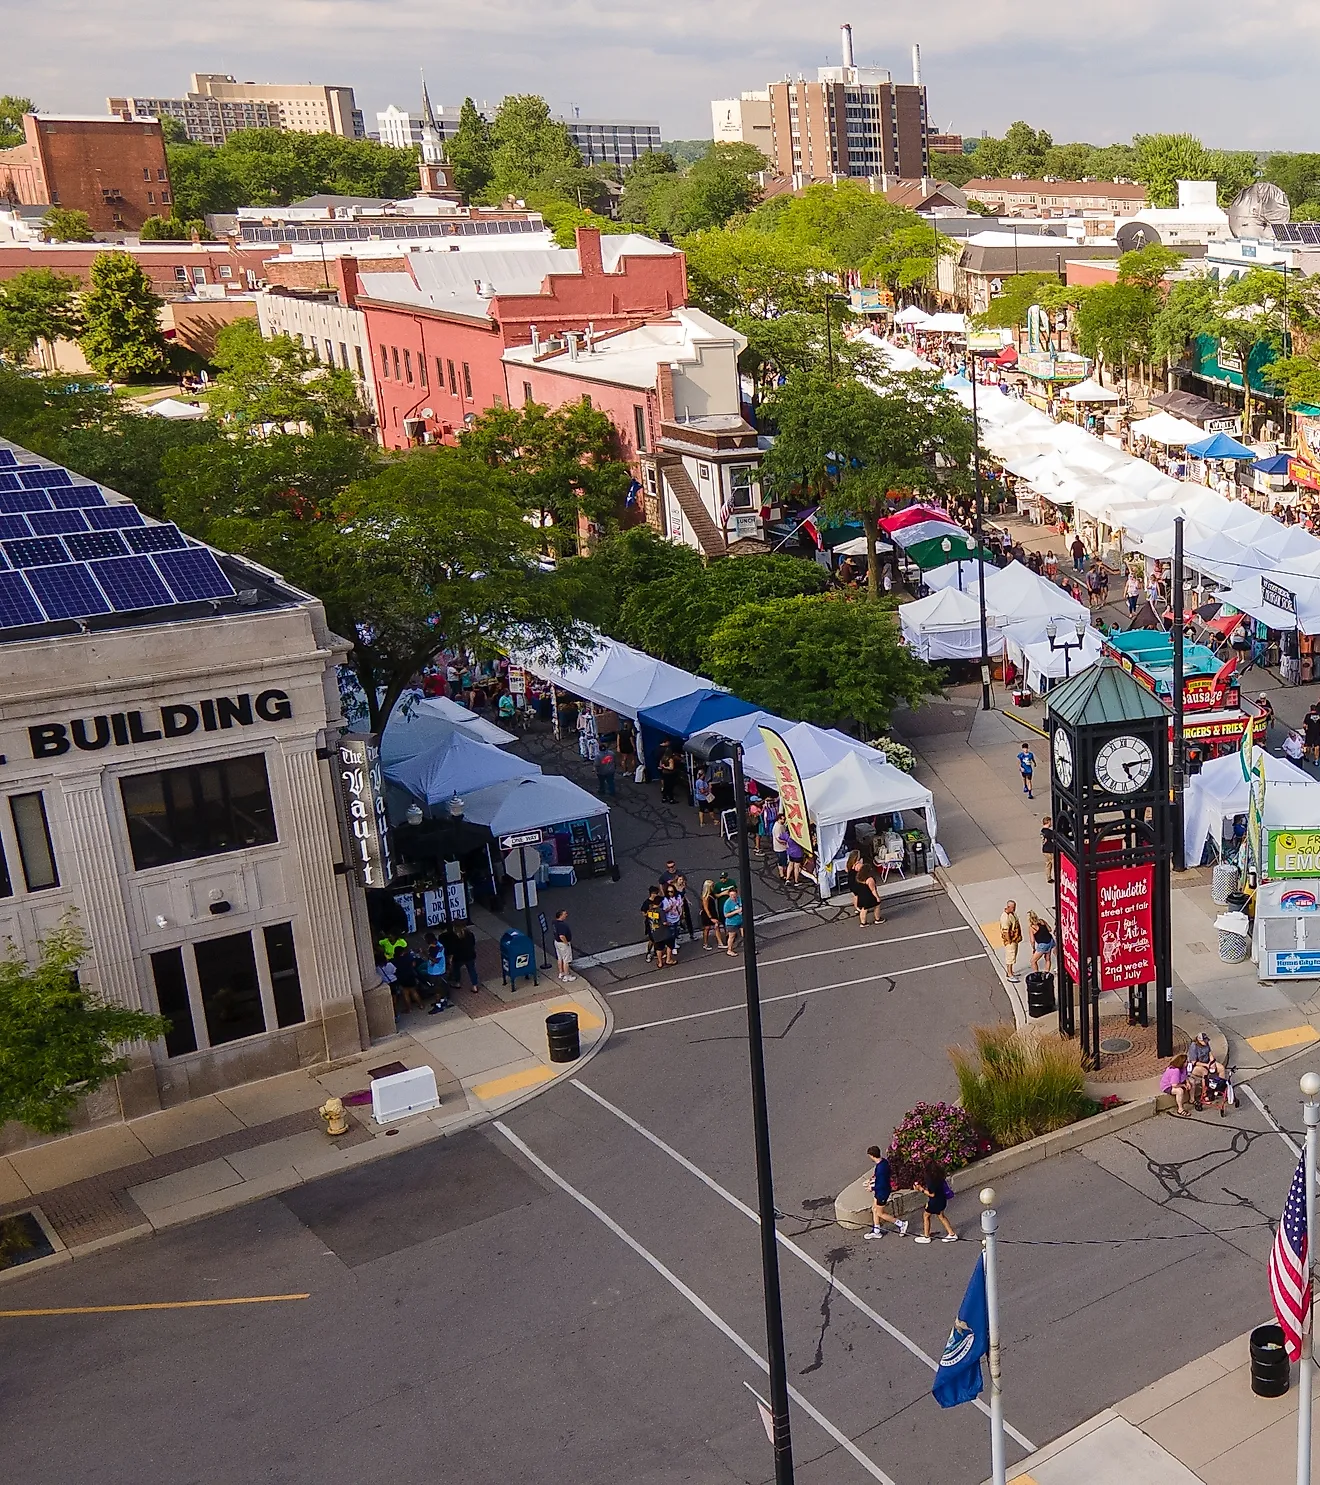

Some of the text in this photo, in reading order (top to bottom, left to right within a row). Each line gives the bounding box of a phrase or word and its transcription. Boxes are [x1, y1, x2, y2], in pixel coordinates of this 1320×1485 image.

[28, 689, 292, 759] BUILDING
[1183, 722, 1244, 739] URGERS & FRIES
[340, 747, 363, 764] The
[342, 768, 374, 885] Vault
[1101, 881, 1147, 907] Wyandotte
[451, 908, 465, 920] ERE
[1101, 901, 1149, 918] street art fair
[1105, 959, 1149, 975] 2nd week
[1114, 970, 1141, 982] in July
